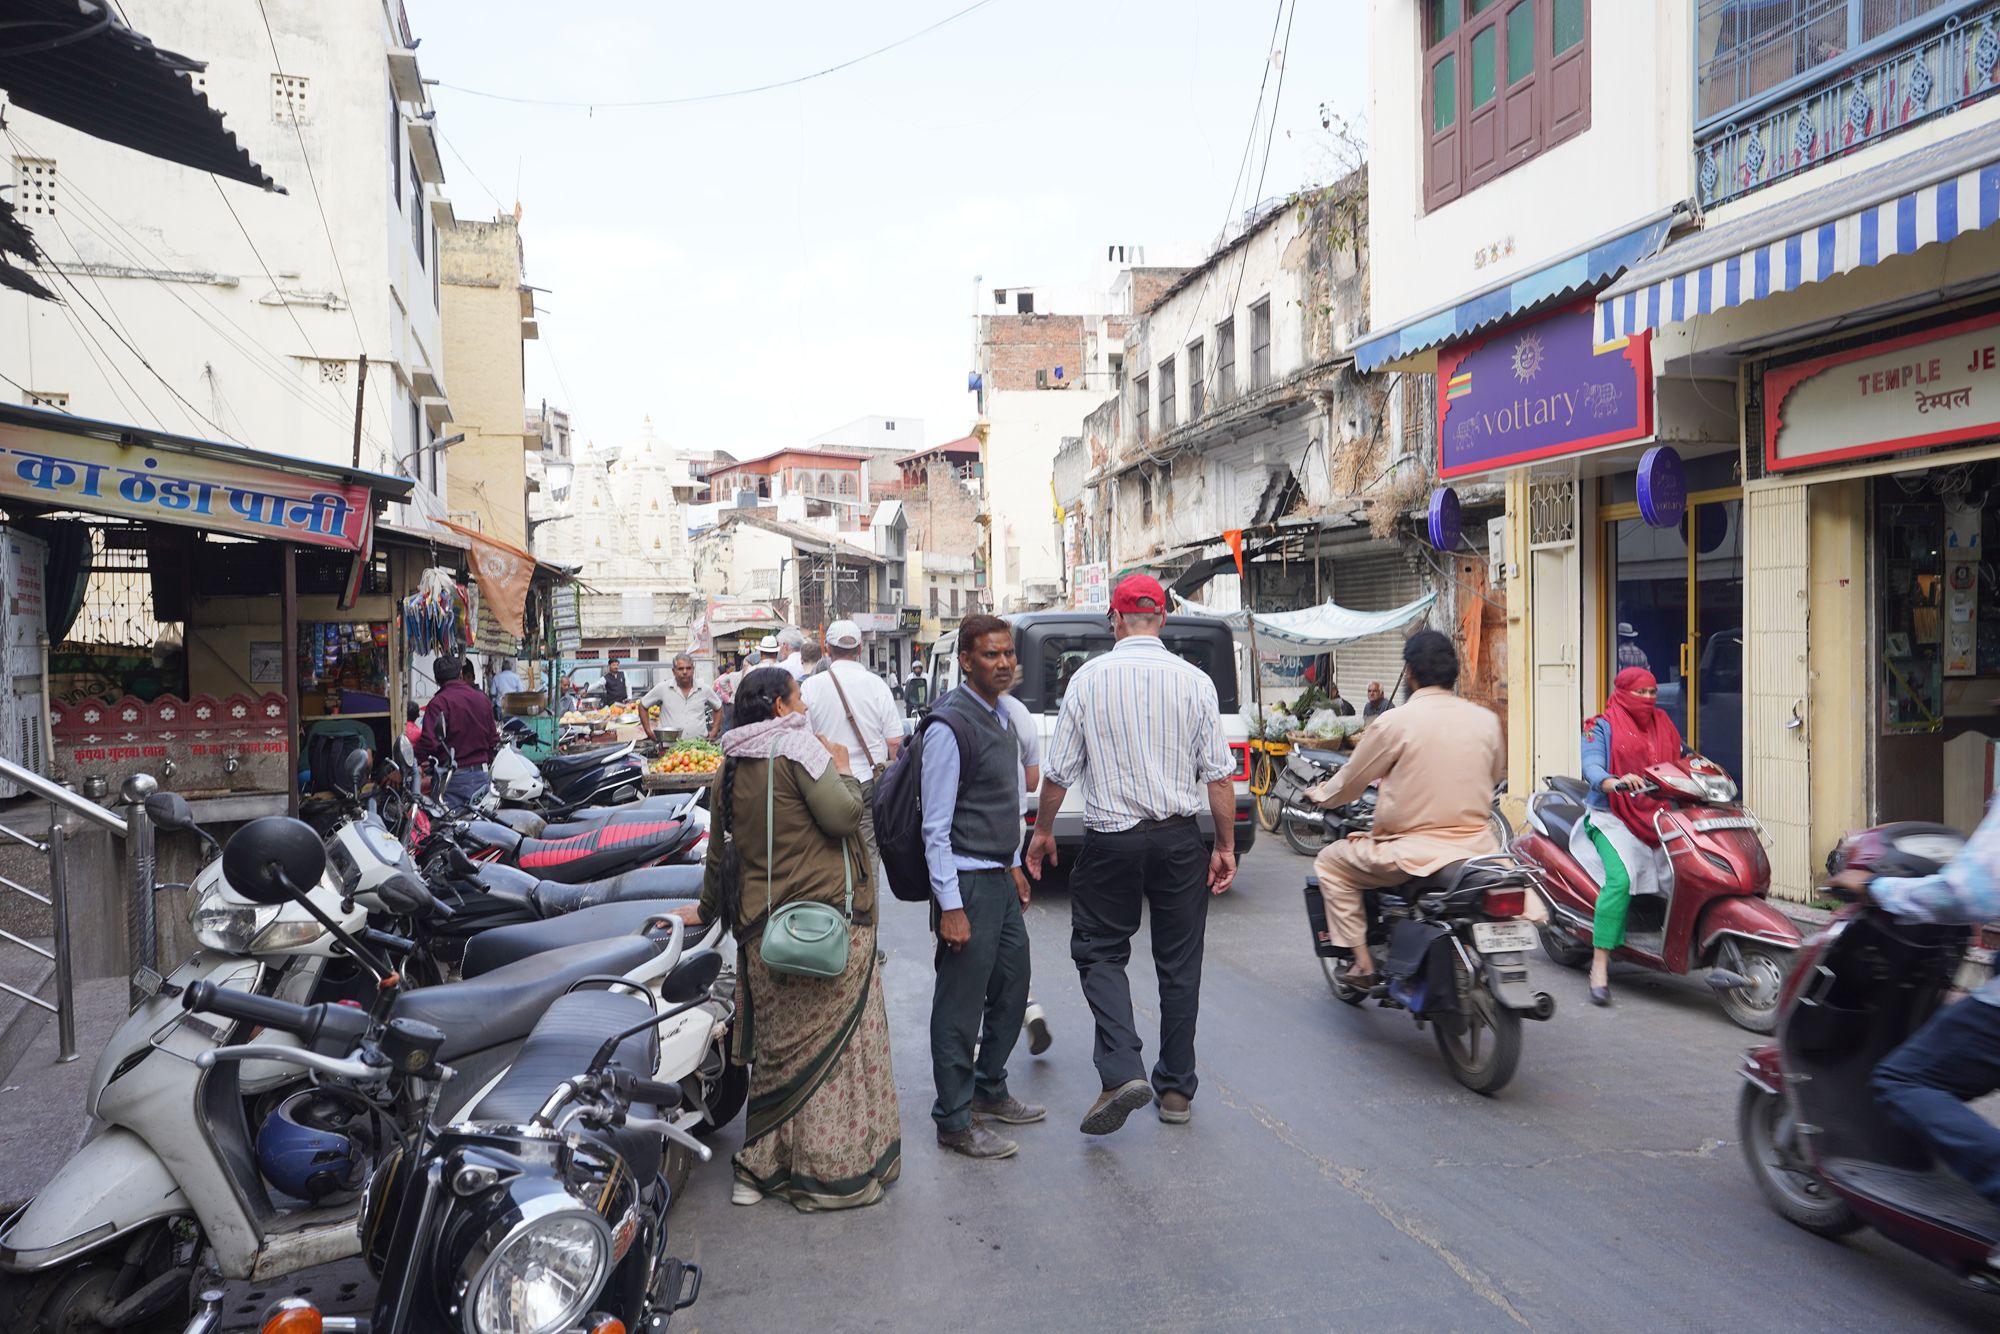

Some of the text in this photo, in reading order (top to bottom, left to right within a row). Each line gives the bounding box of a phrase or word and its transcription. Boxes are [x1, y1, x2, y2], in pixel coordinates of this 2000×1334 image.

[1858, 358, 1941, 396] TEMPLE
[1483, 388, 1579, 437] vottary
[1914, 386, 1972, 414] टेम्पल
[10, 449, 354, 538] का ठंडा पानी
